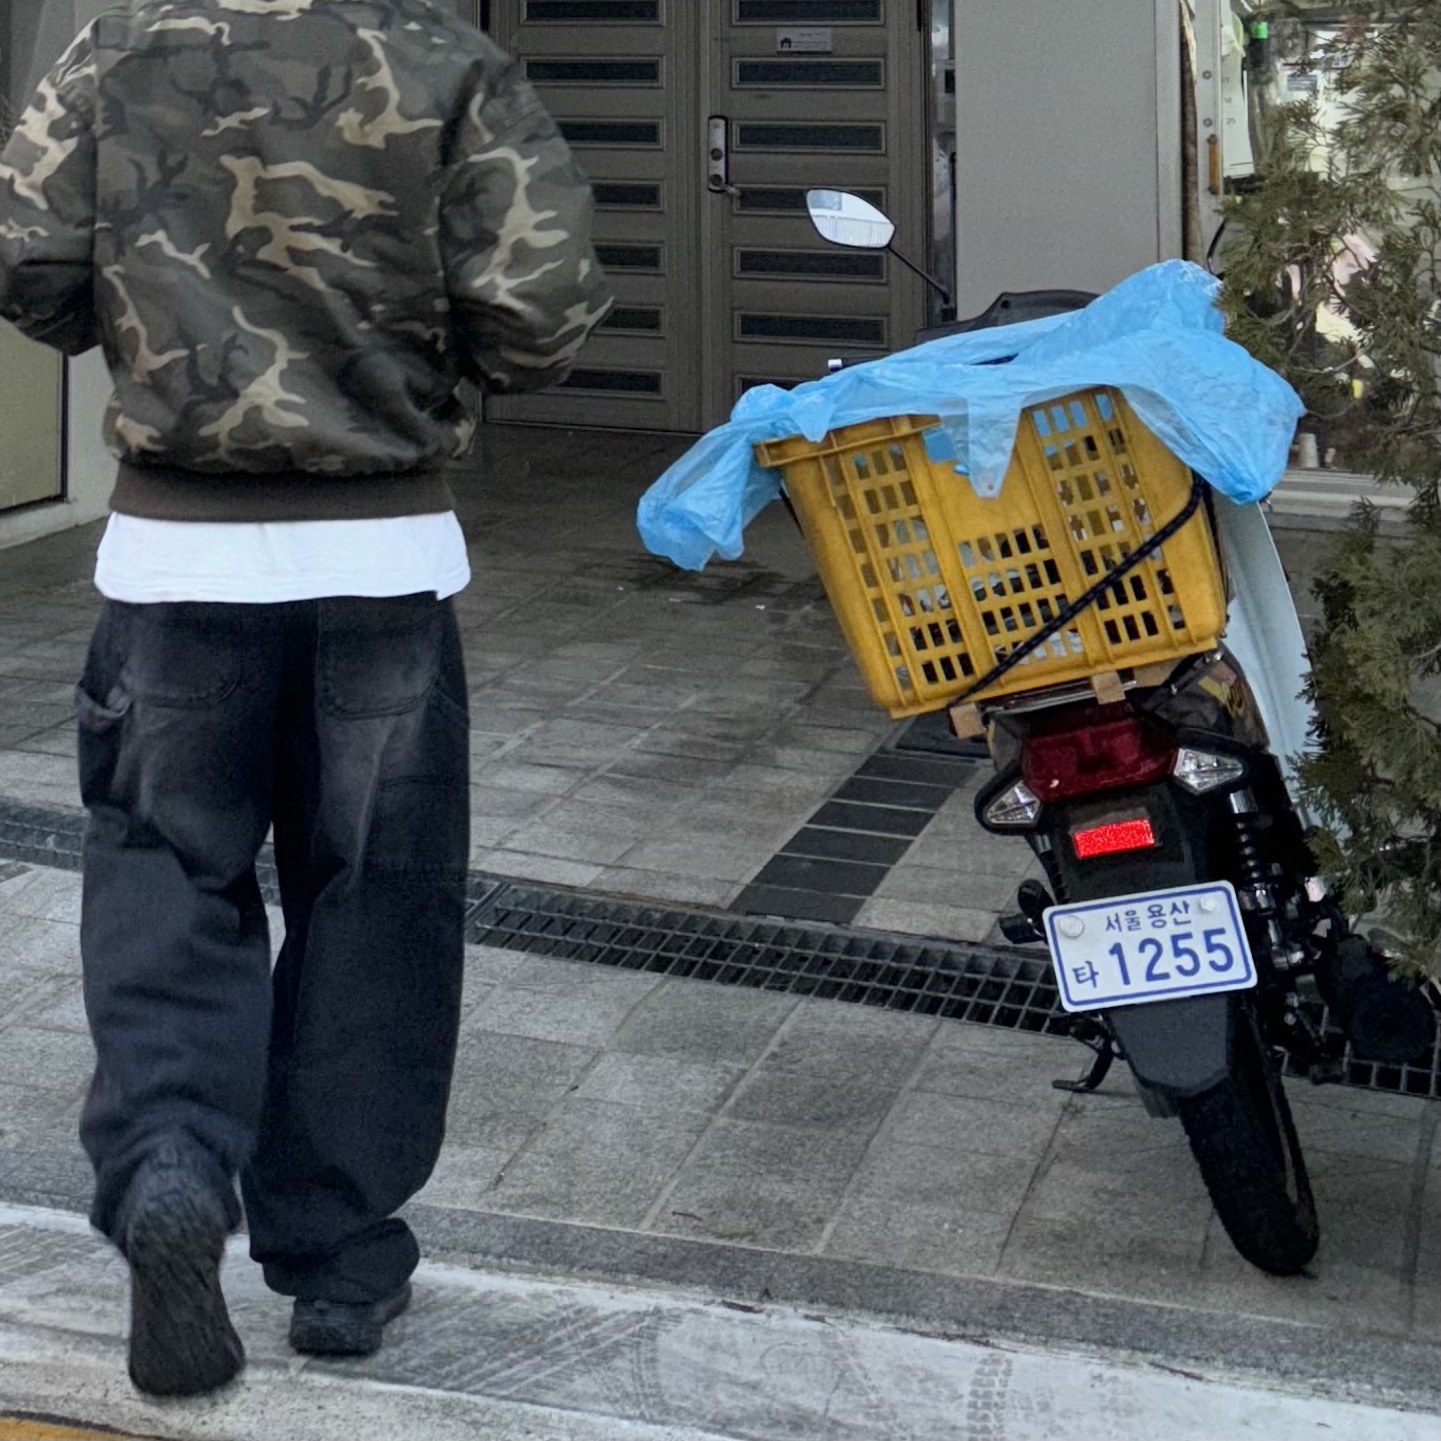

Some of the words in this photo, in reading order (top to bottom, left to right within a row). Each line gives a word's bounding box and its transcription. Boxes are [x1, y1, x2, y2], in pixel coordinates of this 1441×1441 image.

[1105, 910, 1142, 933] 서울
[1147, 900, 1192, 929] 용산
[1072, 960, 1099, 988] 타
[1108, 927, 1234, 986] 1255
